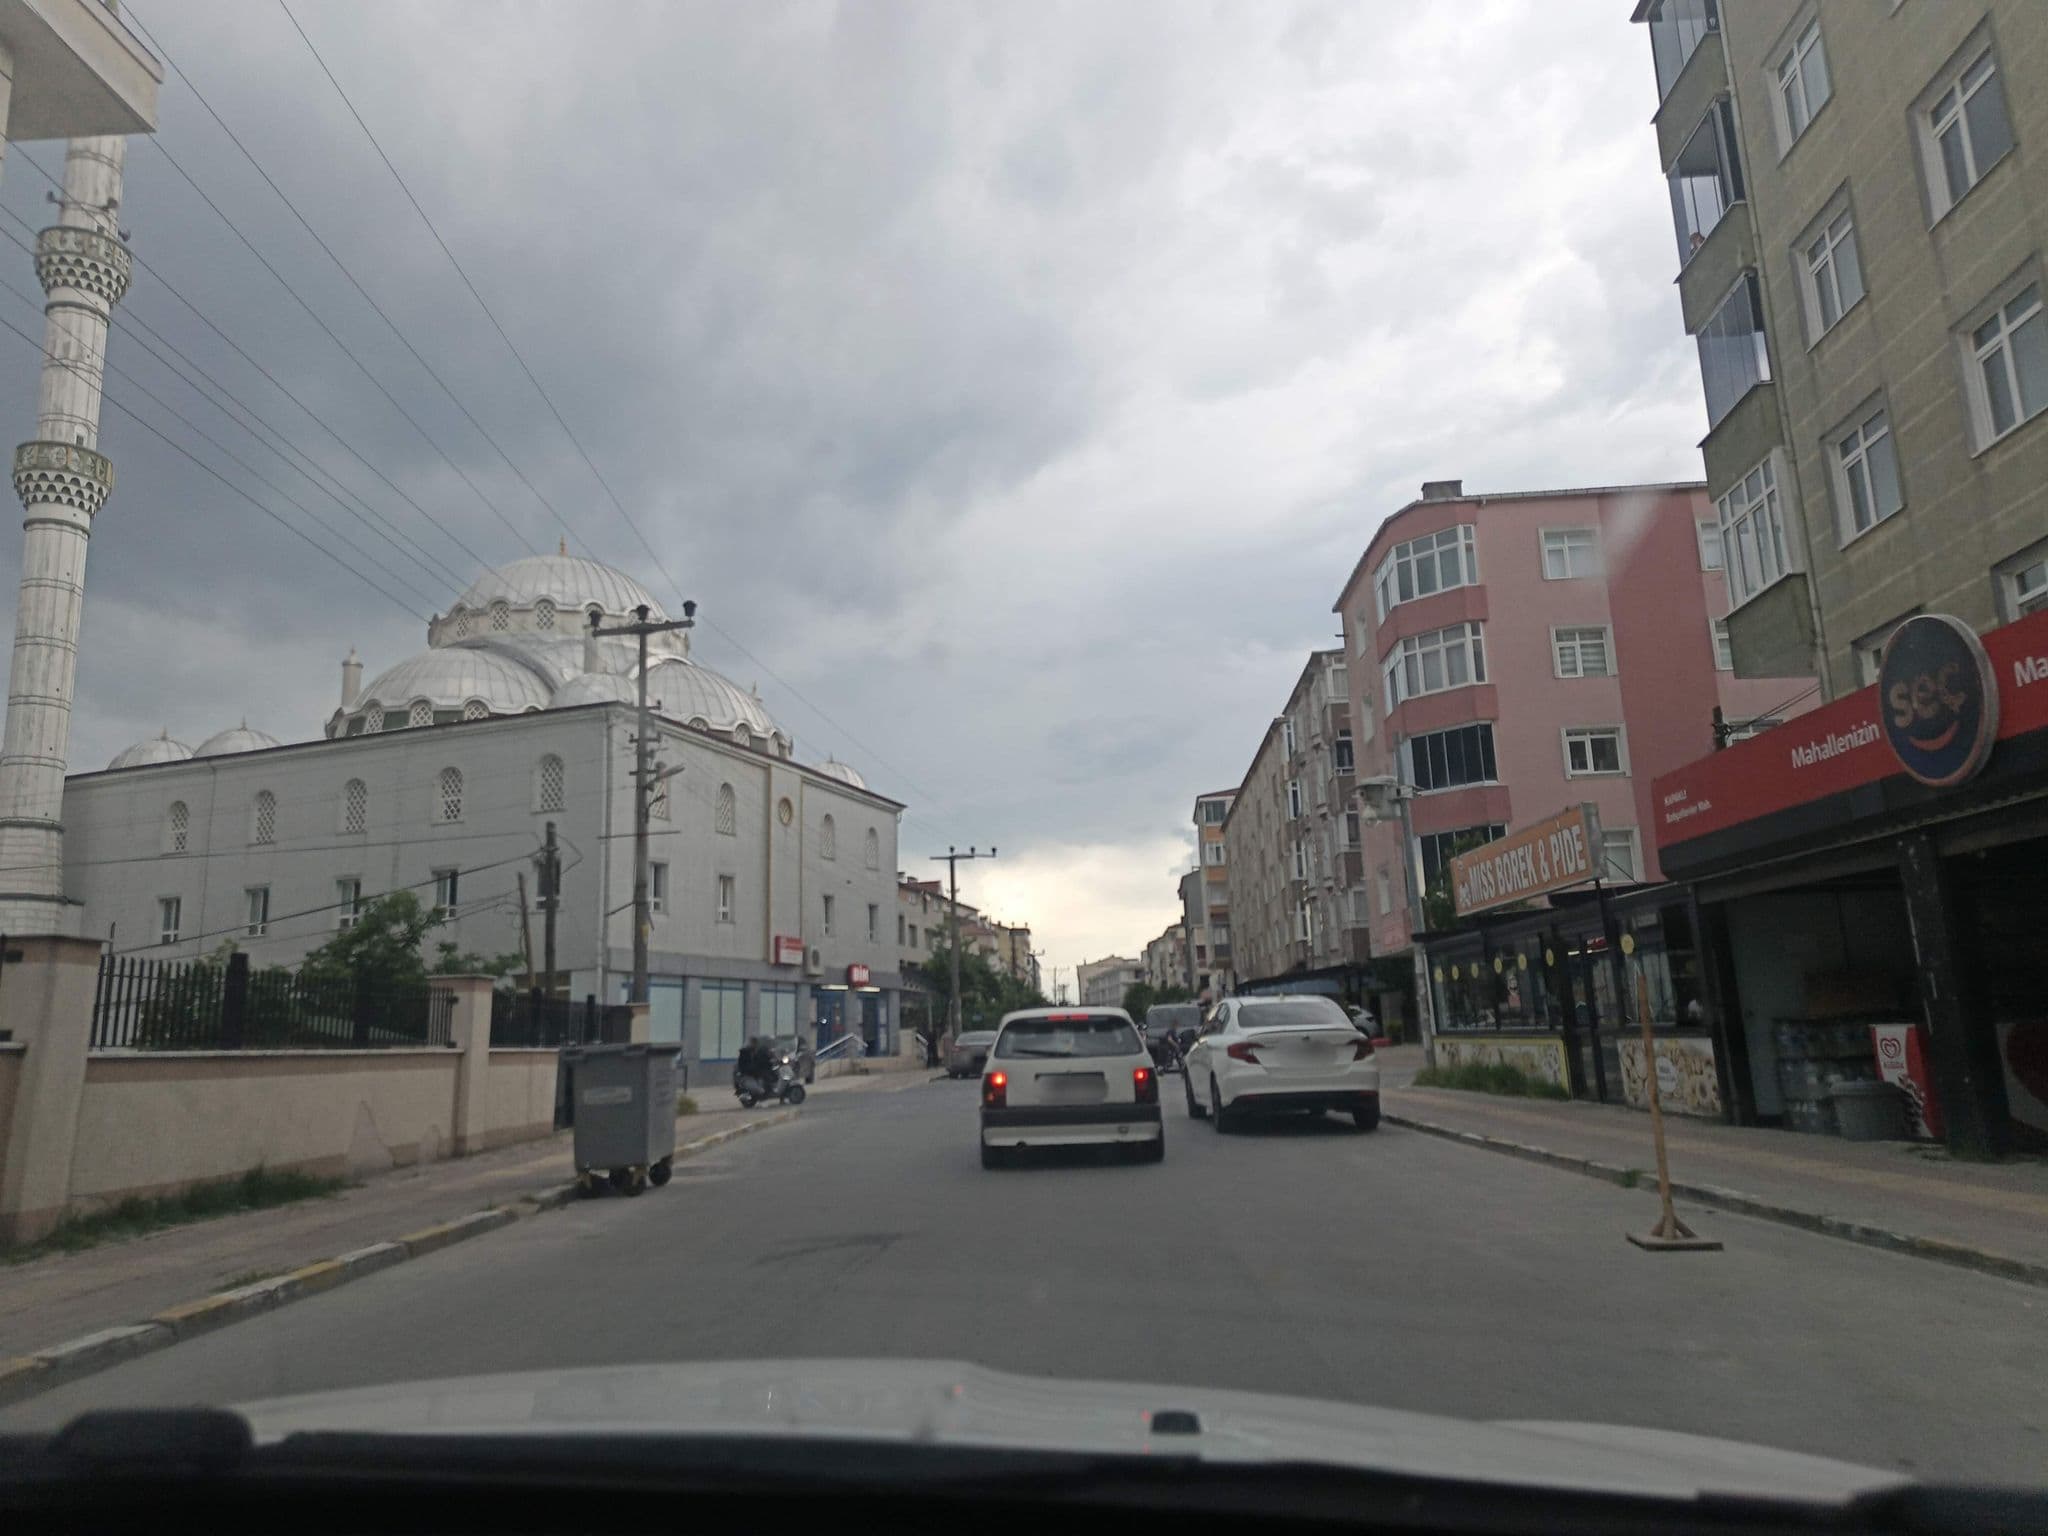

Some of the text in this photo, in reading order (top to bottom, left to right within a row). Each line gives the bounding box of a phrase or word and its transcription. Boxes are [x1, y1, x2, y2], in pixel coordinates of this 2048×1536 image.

[1791, 720, 1881, 769] Mahallenizin
[1538, 839, 1550, 883] &
[1550, 820, 1586, 879] PİDE
